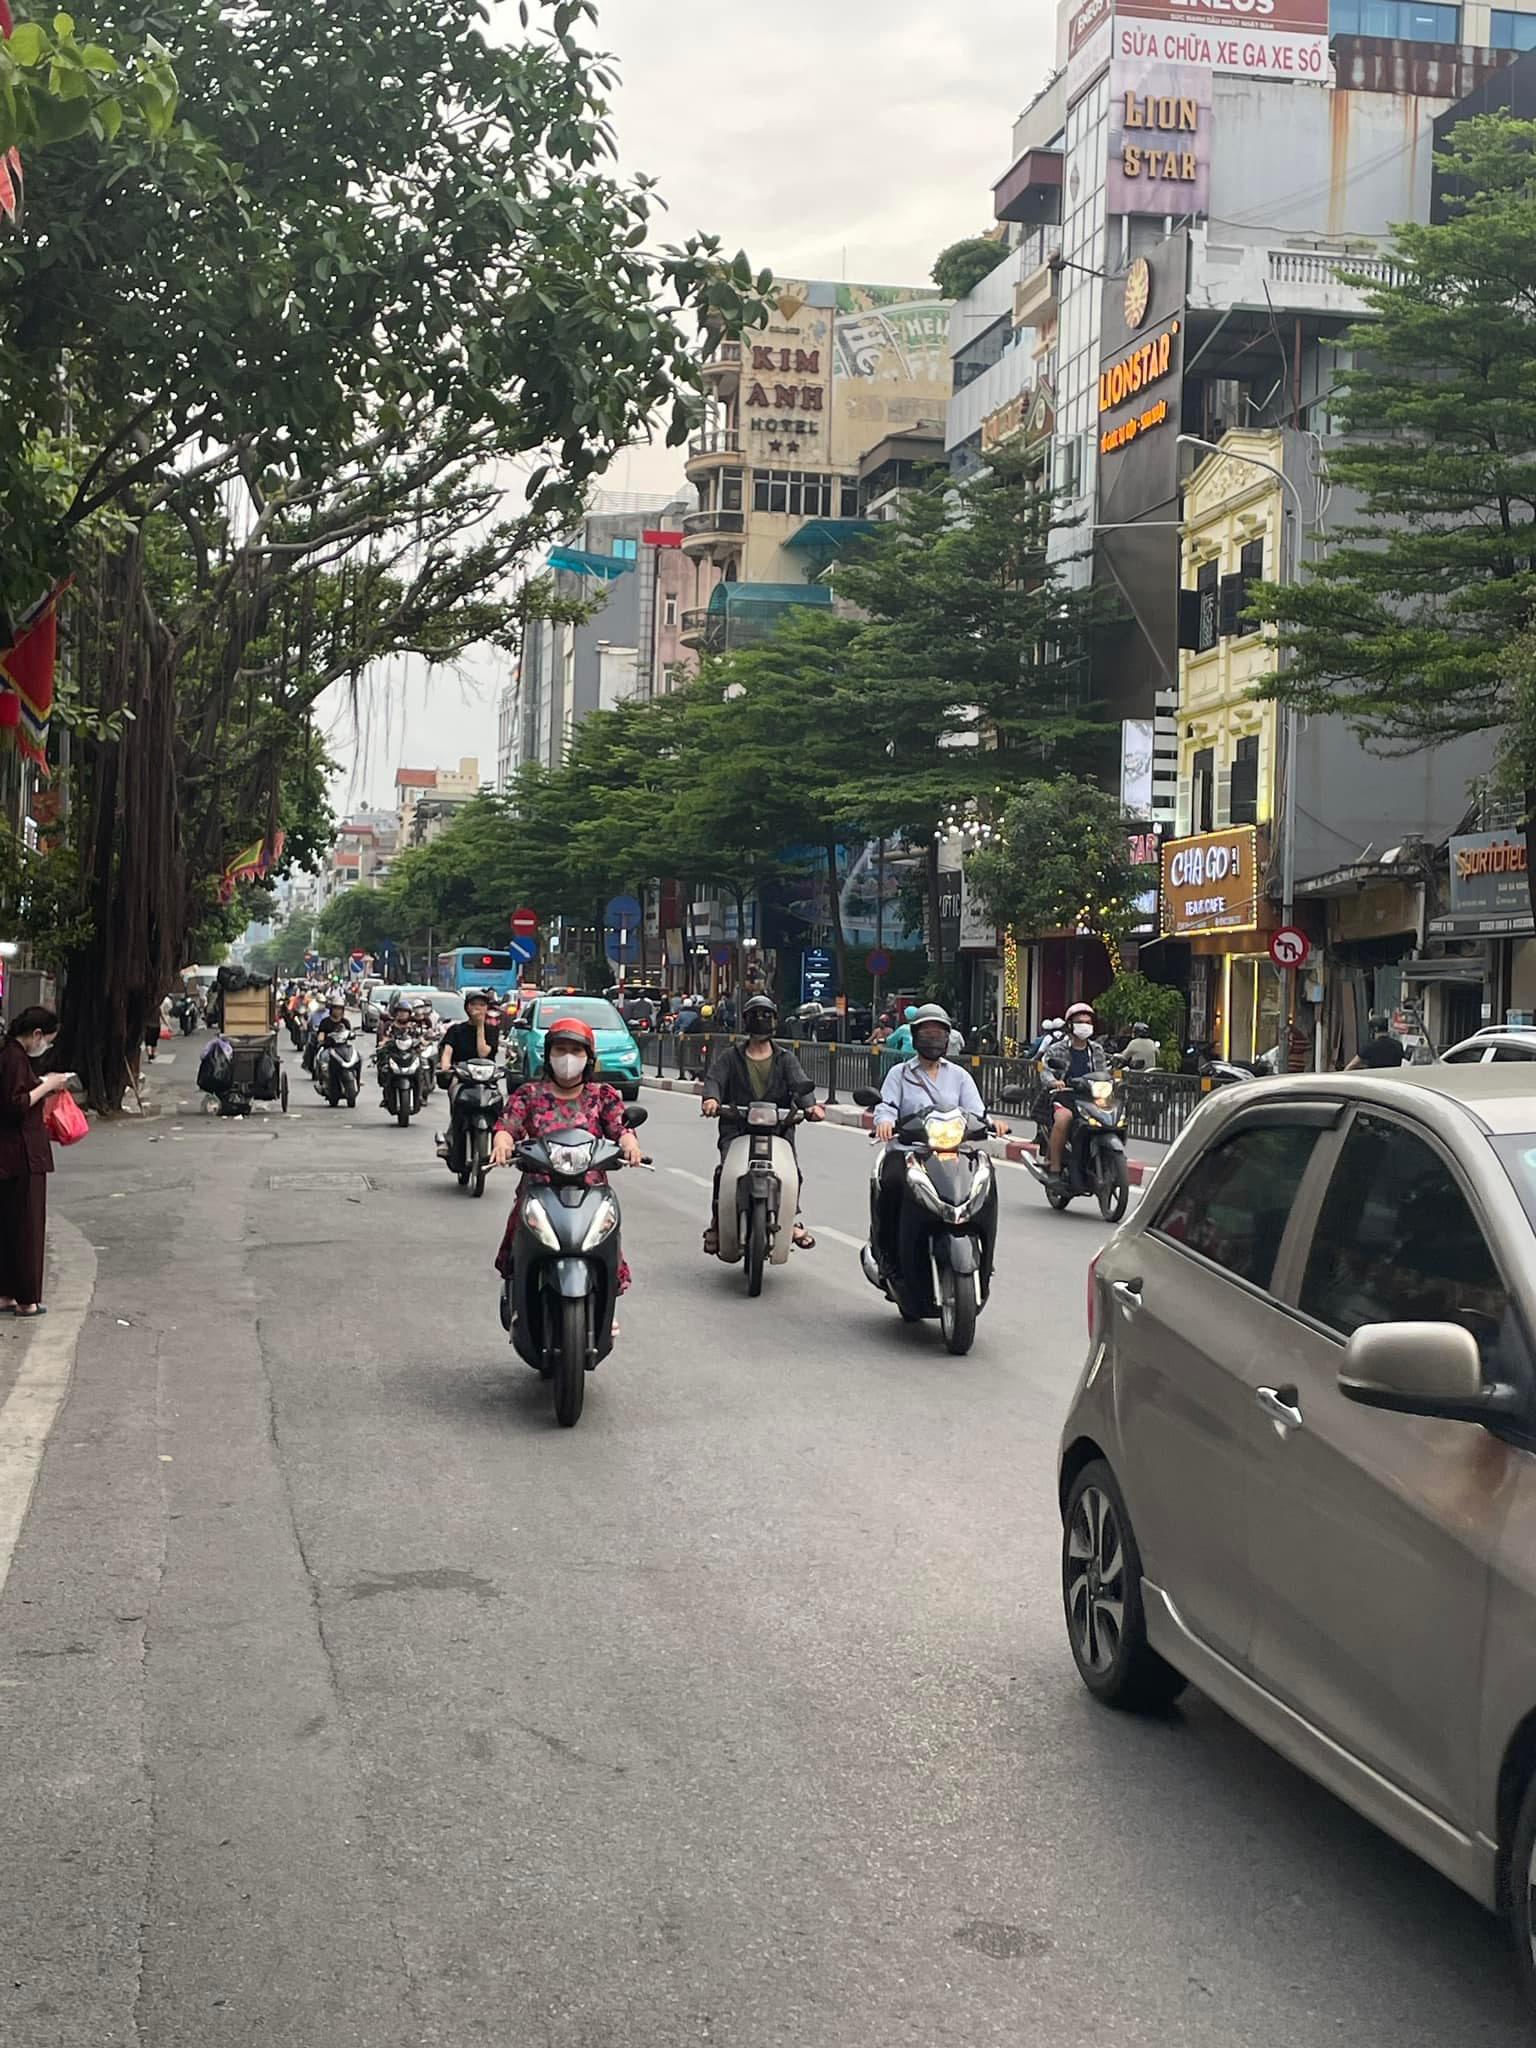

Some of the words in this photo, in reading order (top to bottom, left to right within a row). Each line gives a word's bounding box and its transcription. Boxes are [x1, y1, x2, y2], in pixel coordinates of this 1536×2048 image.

[1121, 26, 1158, 57] SỬA
[1164, 33, 1211, 63] CHỮA
[1216, 41, 1239, 65] XE
[1243, 43, 1267, 68] GA
[1272, 46, 1293, 70] XE
[1298, 41, 1322, 73] SỐ
[1123, 89, 1197, 132] LION
[1123, 145, 1196, 181] STAR
[752, 345, 819, 374] KIM
[1099, 332, 1170, 412] LIONSTAR
[745, 381, 823, 411] ANH
[751, 417, 819, 434] HOTEL
